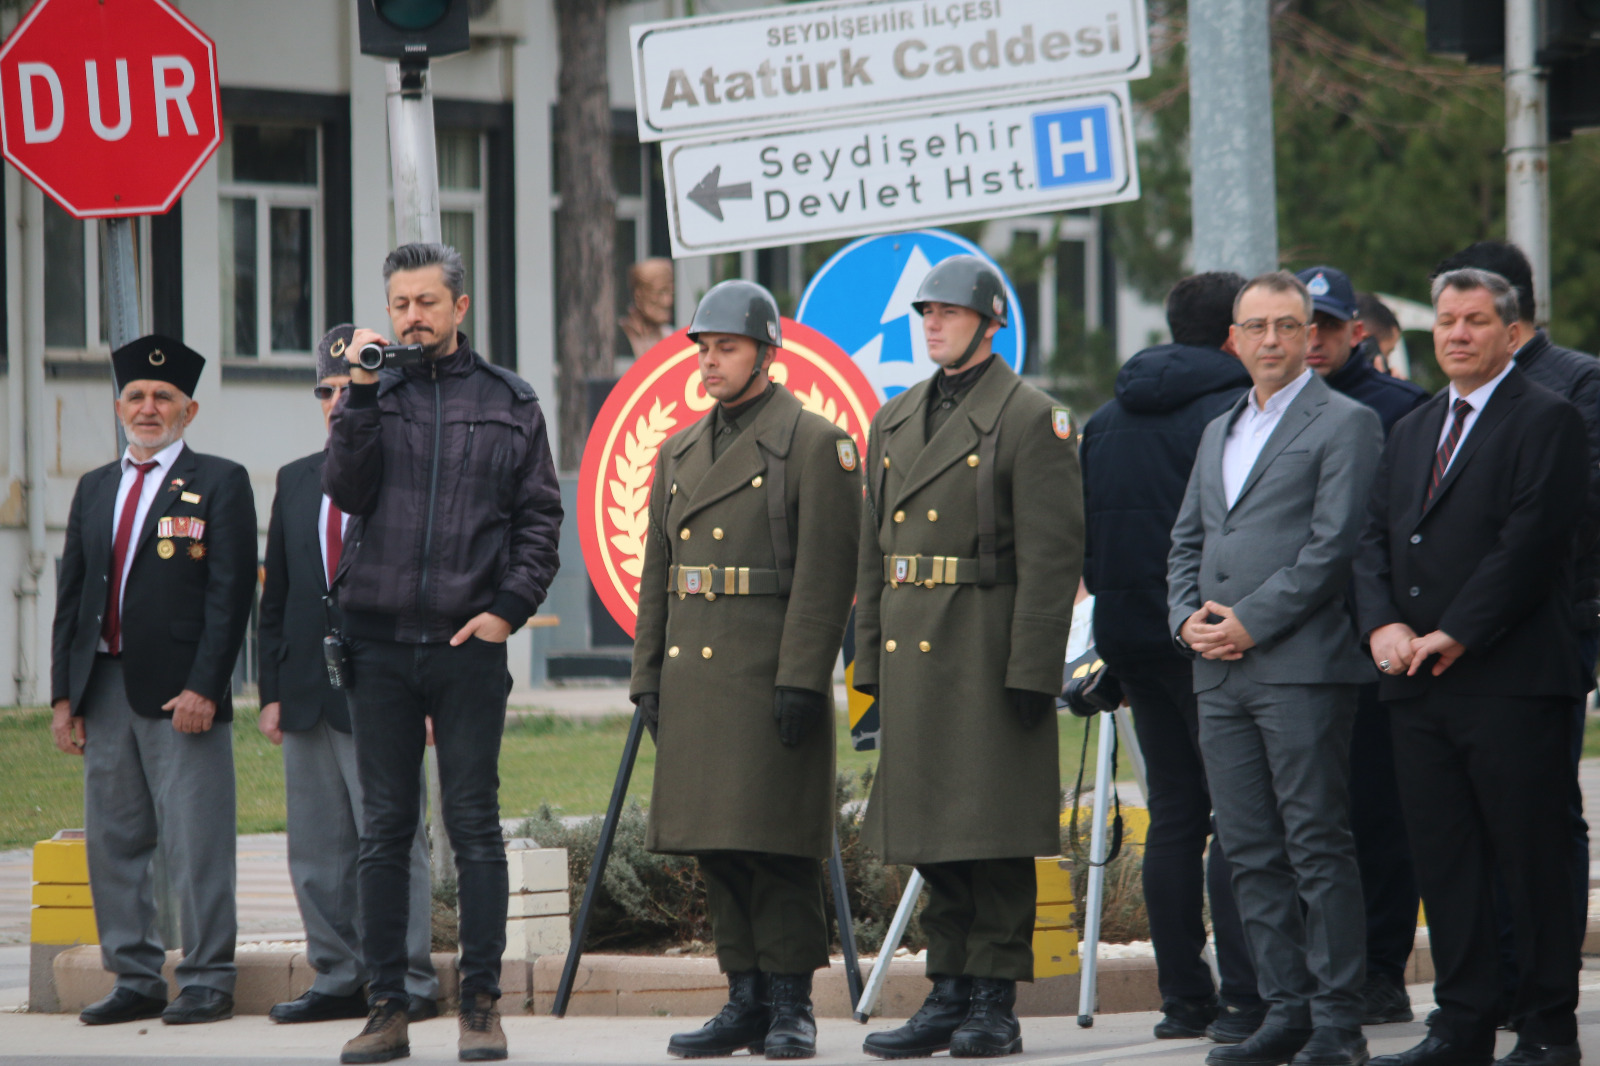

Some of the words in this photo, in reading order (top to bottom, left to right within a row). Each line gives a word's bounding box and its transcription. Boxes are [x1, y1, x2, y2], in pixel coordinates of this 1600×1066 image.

[766, 8, 915, 47] SEYDİŞEHİR
[659, 46, 874, 111] Atatürk
[892, 12, 1121, 81] Caddesi
[18, 54, 199, 144] DUR
[759, 120, 1022, 182] Seydişehir
[1048, 116, 1098, 178] H
[764, 174, 922, 222] Devlet
[944, 160, 1035, 199] Hst.
